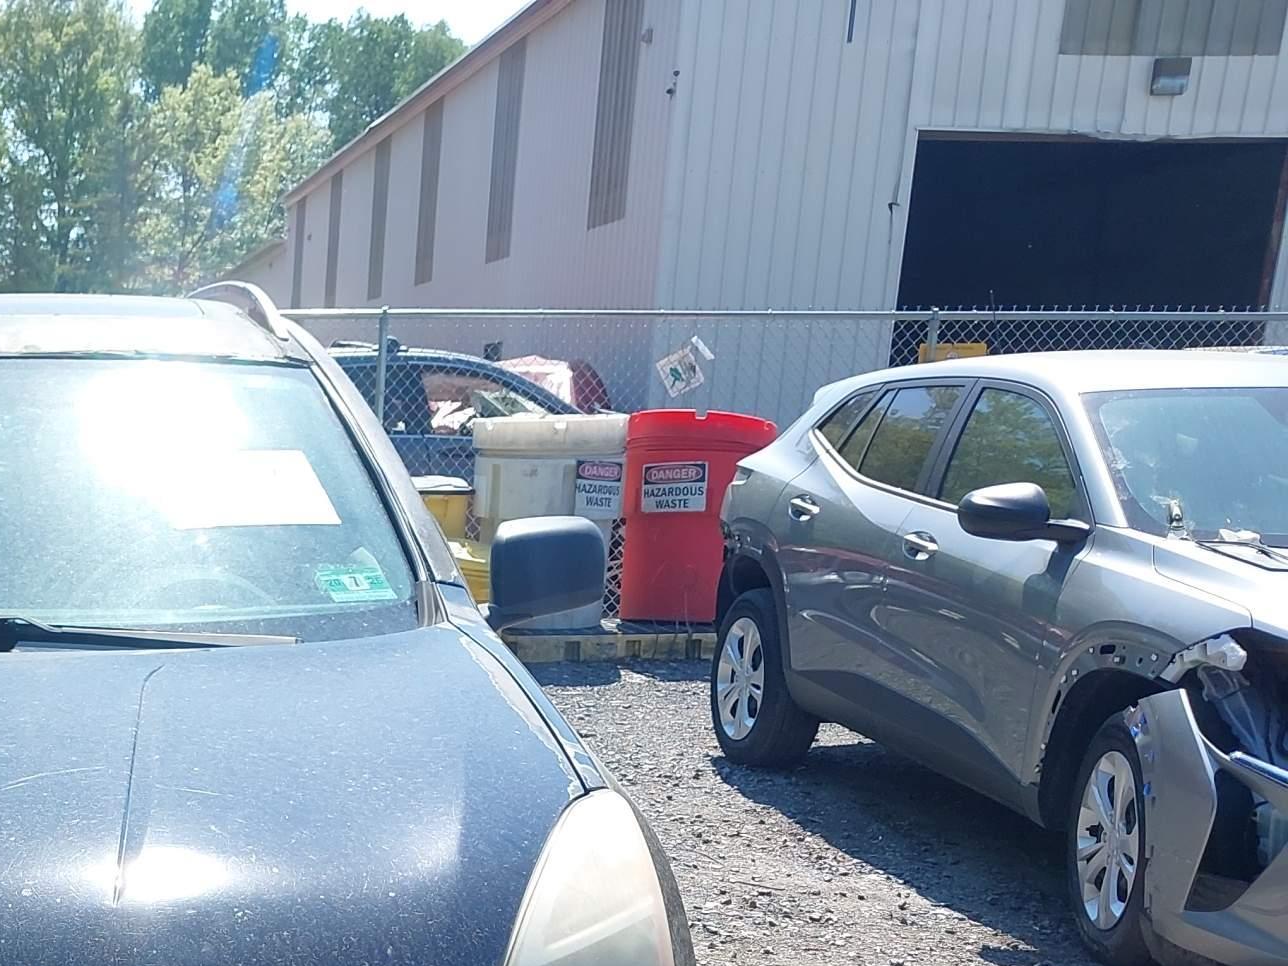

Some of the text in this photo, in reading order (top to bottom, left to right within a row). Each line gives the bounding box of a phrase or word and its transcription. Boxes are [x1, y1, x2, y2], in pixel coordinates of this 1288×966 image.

[584, 464, 618, 478] DANGER
[651, 468, 697, 481] DANGER
[575, 483, 620, 496] HAZARDOUS
[643, 486, 705, 498] HAZARDOUS
[585, 496, 613, 508] WASTE
[655, 498, 689, 509] WASTE
